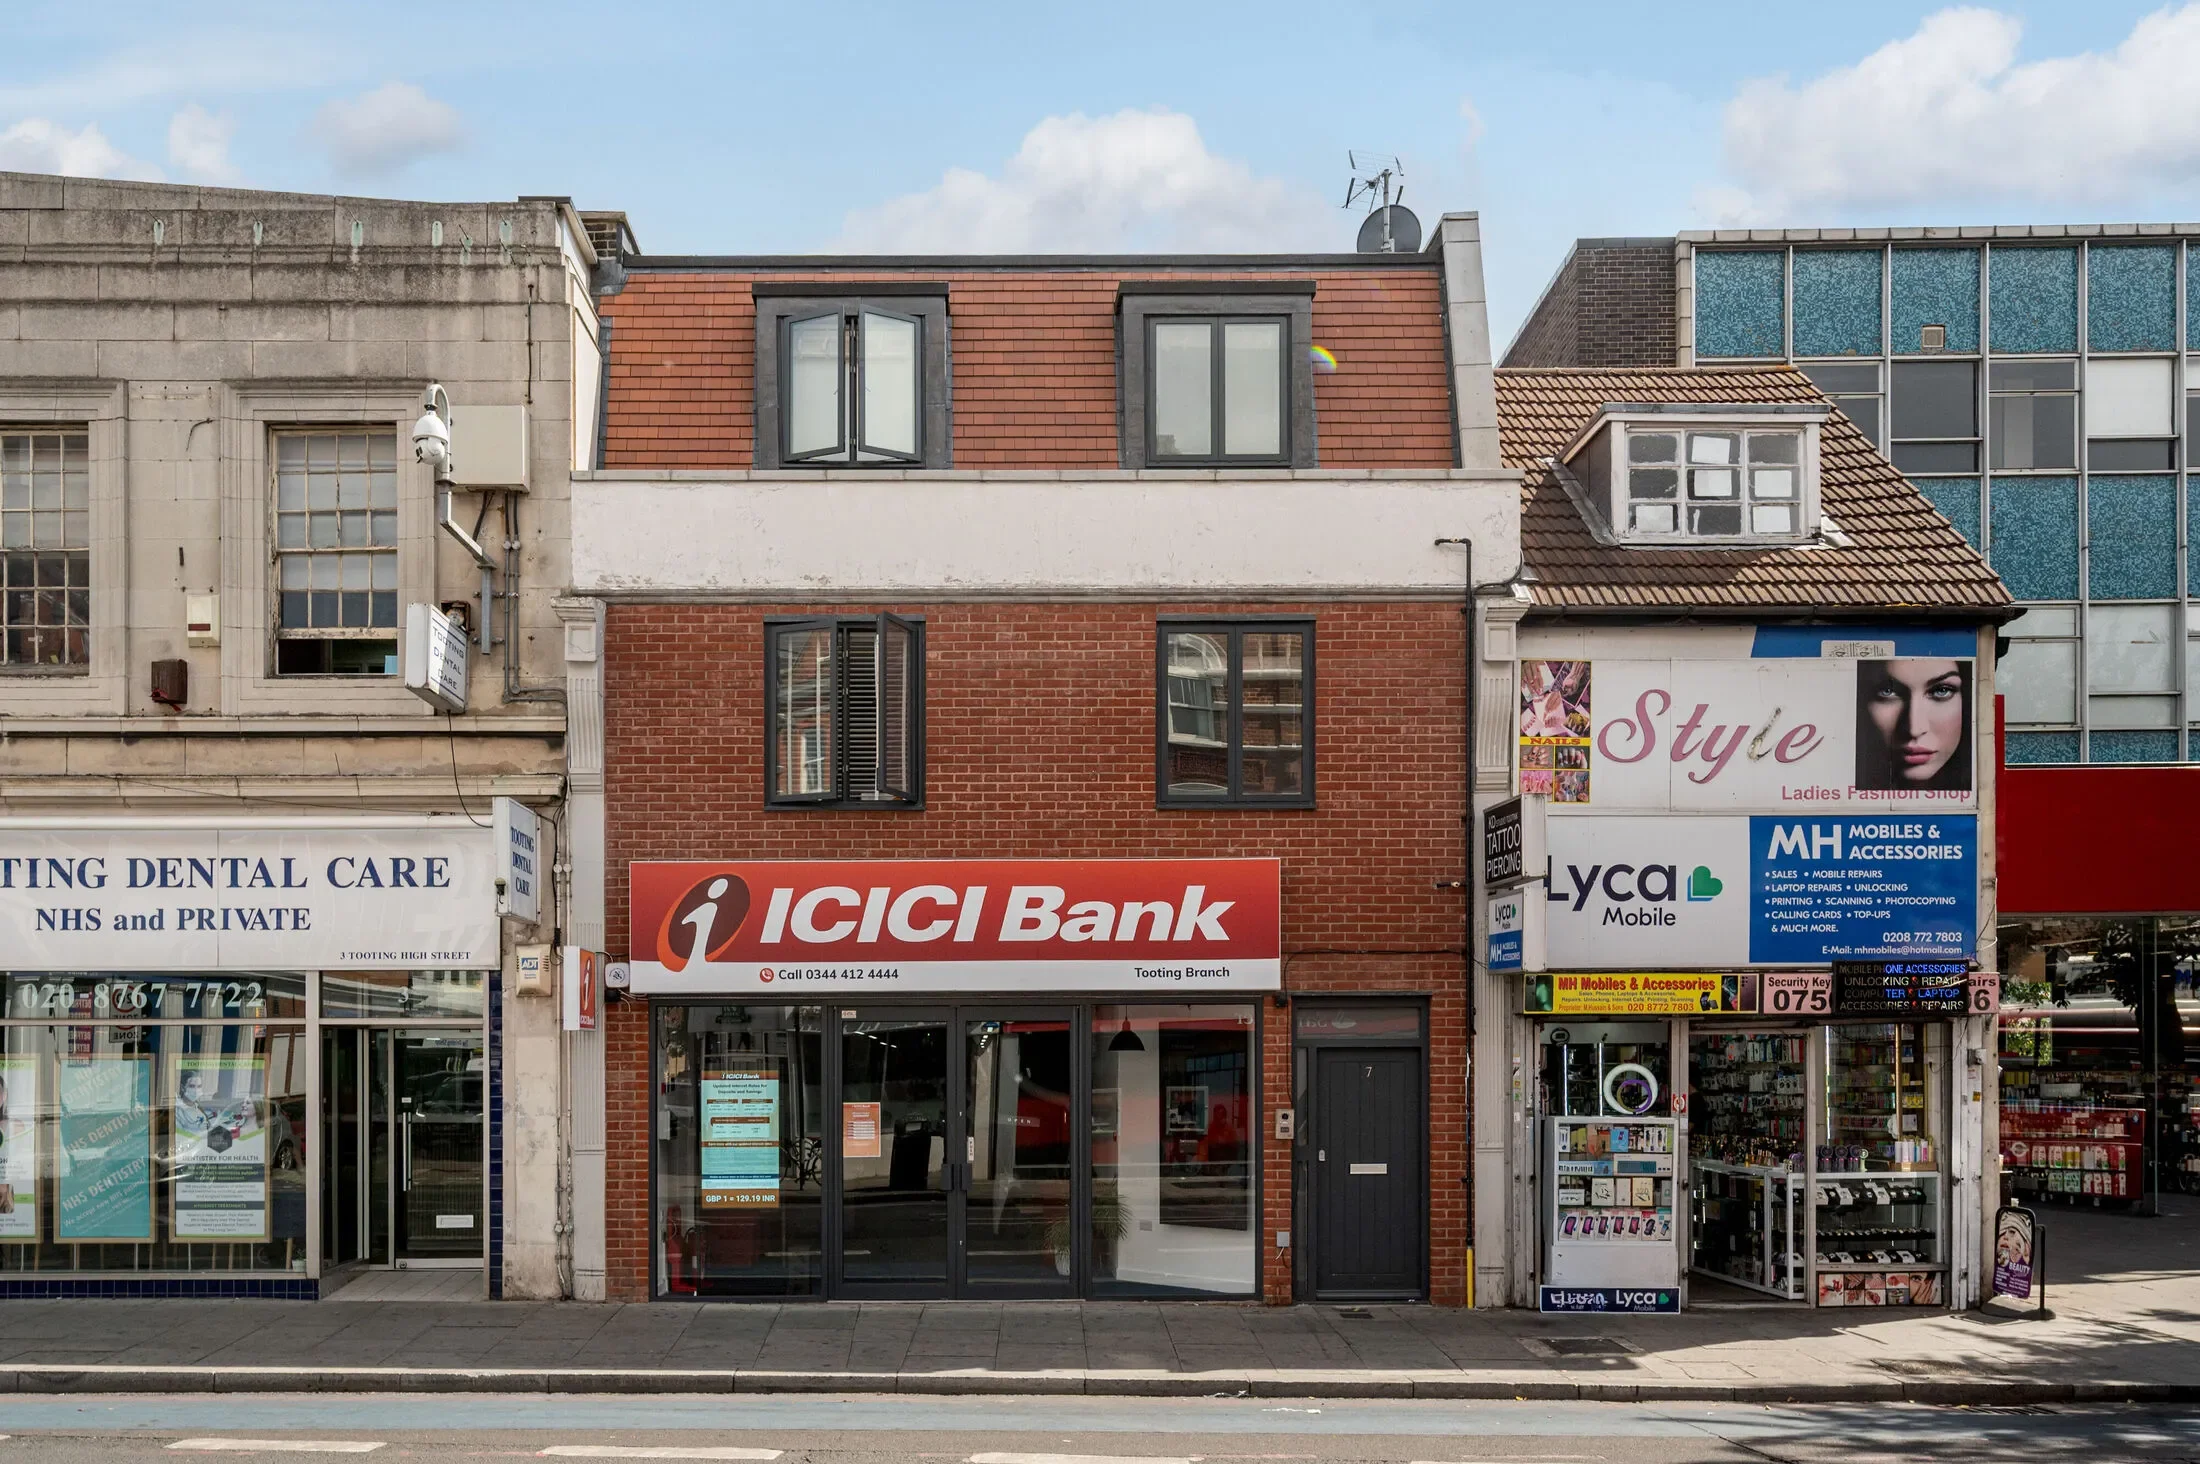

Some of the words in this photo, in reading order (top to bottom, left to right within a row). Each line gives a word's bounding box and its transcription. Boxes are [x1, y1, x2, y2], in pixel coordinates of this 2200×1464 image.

[433, 626, 464, 659] TOOTING
[433, 646, 462, 675] DENTAL
[438, 669, 458, 690] CARE
[1530, 737, 1581, 746] NAILS
[1781, 785, 1841, 801] Ladies
[1847, 785, 1920, 801] Fashion
[1924, 788, 1972, 803] Shop
[510, 826, 535, 854] TOOTING
[1487, 823, 1521, 856] TATTOO
[1767, 824, 1842, 860] MH
[1849, 824, 1923, 839] MOBILES
[1928, 824, 1940, 839] &
[1849, 845, 1963, 860] ACCESSORIES
[512, 851, 533, 876] DENTAL
[1487, 851, 1522, 880] PIERCING
[126, 857, 308, 889] DENTAL
[326, 856, 450, 889] CARE
[1771, 870, 1798, 879] SALES
[1812, 870, 1846, 879] MOBILE
[1848, 870, 1883, 879] REPAIRS
[515, 876, 530, 897] CARE
[1544, 855, 1677, 912] Lyca
[1771, 884, 1805, 892] LAPTOP
[1807, 884, 1842, 892] REPAIRS
[1854, 883, 1908, 892] UNLOCKING
[1771, 897, 1813, 906] PRINTING
[1825, 897, 1873, 906] SCANNING
[1885, 896, 1956, 905] PHOTOCOPYING
[35, 907, 102, 931] NHS
[113, 908, 165, 931] and
[176, 907, 311, 931] PRIVATE
[760, 885, 987, 943] ICICI
[998, 885, 1236, 942] Bank
[1495, 904, 1511, 925] Lyca
[1602, 907, 1676, 926] Mobile
[1771, 911, 1809, 919] CALLING
[1812, 910, 1842, 919] CARDS
[1854, 910, 1891, 919] TOP-UPS
[1771, 925, 1778, 933] &
[1780, 924, 1808, 933] MUCH
[1810, 924, 1839, 933] MORE.
[1883, 932, 1911, 942] 0208
[1914, 932, 1932, 942] 772
[1935, 932, 1962, 942] 7803
[340, 951, 346, 960] 3
[349, 951, 397, 960] TOOTING
[400, 951, 427, 960] HIGH
[431, 951, 471, 960] STREET
[1489, 942, 1502, 963] MH
[1822, 946, 1852, 955] E-Mail:
[1854, 945, 1962, 955] mhmobiles@hotmail.com
[521, 958, 539, 970] ADT
[1839, 965, 1872, 974] MOBILE
[1905, 964, 1966, 974] ACCESSORIES
[778, 969, 802, 980] Call
[806, 968, 837, 980] 0344
[841, 968, 864, 980] 412
[868, 968, 899, 979] 4444
[1135, 967, 1182, 980] Tooting
[1186, 966, 1230, 978] Branch
[1844, 976, 1909, 986] UNLOCKING
[1558, 977, 1577, 990] MH
[1581, 976, 1626, 991] Mobiles
[1630, 977, 1638, 990] &
[1642, 977, 1715, 991] Accessories
[1768, 977, 1808, 989] Security
[22, 983, 75, 1009] 020
[93, 983, 167, 1009] 8767
[185, 982, 264, 1009] 7722
[398, 986, 409, 1003] 3
[1774, 990, 1832, 1011] 075
[1844, 988, 1905, 998] COMPUTER
[1918, 988, 1960, 998] LAPTOP
[1628, 1003, 1645, 1011] 020
[1648, 1003, 1669, 1011] 8772
[1672, 1003, 1694, 1011] 7803
[1839, 1001, 1910, 1011] ACCESSORIES
[1921, 1001, 1964, 1011] REPAIRS
[1364, 1066, 1373, 1078] 7
[88, 1106, 145, 1144] DENTISTRY
[63, 1191, 88, 1211] NHS
[88, 1156, 146, 1197] DENTISTRY
[706, 1194, 721, 1202] GBP
[736, 1194, 760, 1202] 129.19
[762, 1194, 776, 1202] INR
[2009, 1261, 2030, 1275] BEAUTY
[1616, 1290, 1657, 1307] Lyca
